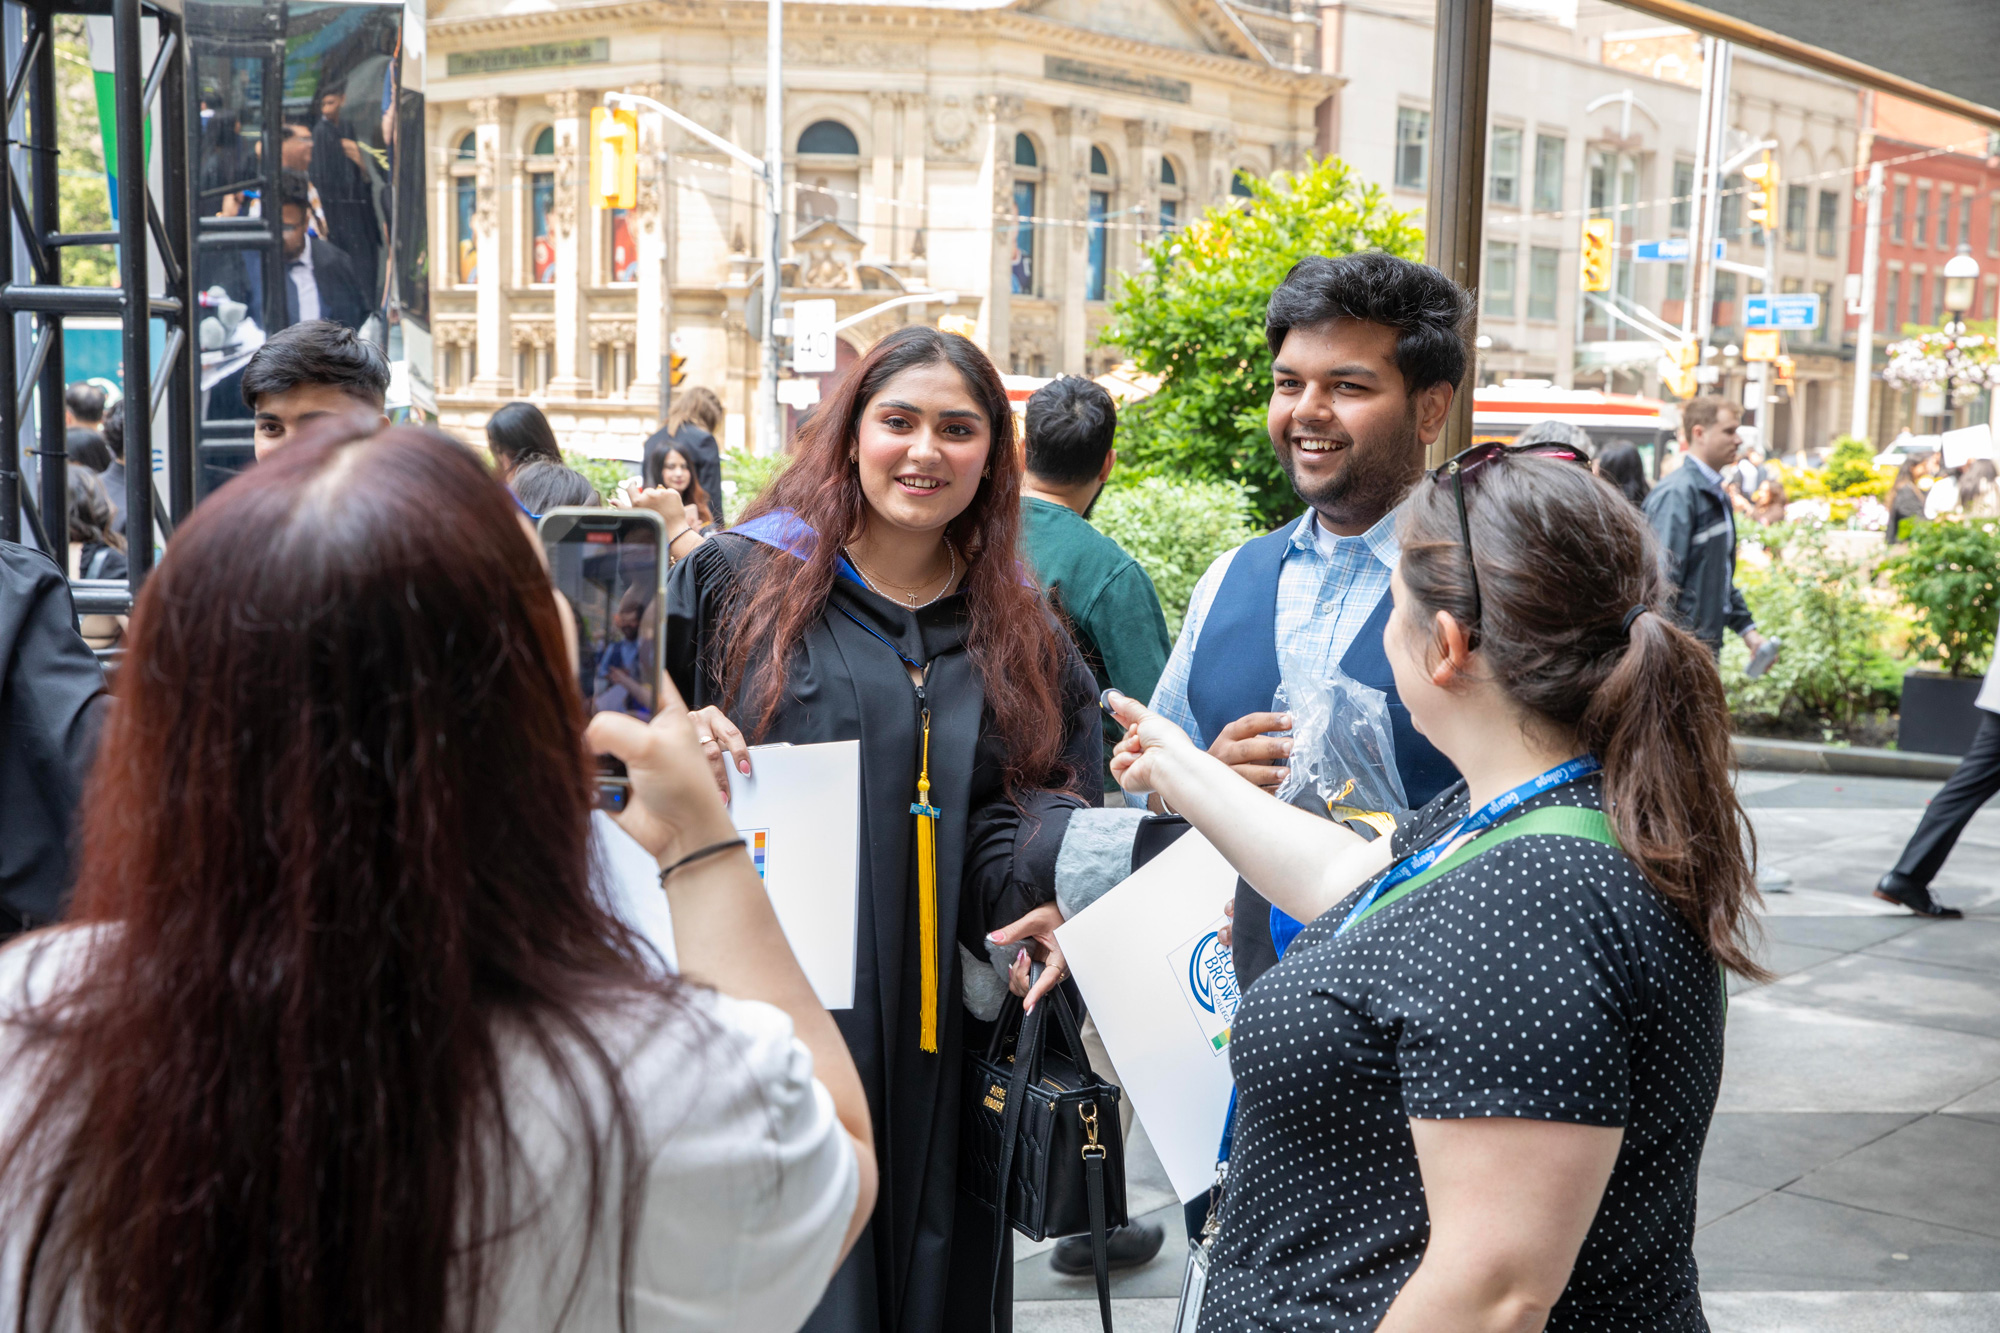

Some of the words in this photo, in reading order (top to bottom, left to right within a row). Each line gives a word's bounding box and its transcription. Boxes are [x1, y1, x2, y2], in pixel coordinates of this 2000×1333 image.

[800, 332, 829, 358] 40
[1534, 766, 1569, 788] College
[1488, 791, 1520, 815] George
[1410, 850, 1436, 870] George
[1204, 955, 1239, 1016] BROWN
[1213, 992, 1232, 1024] COLLEGE
